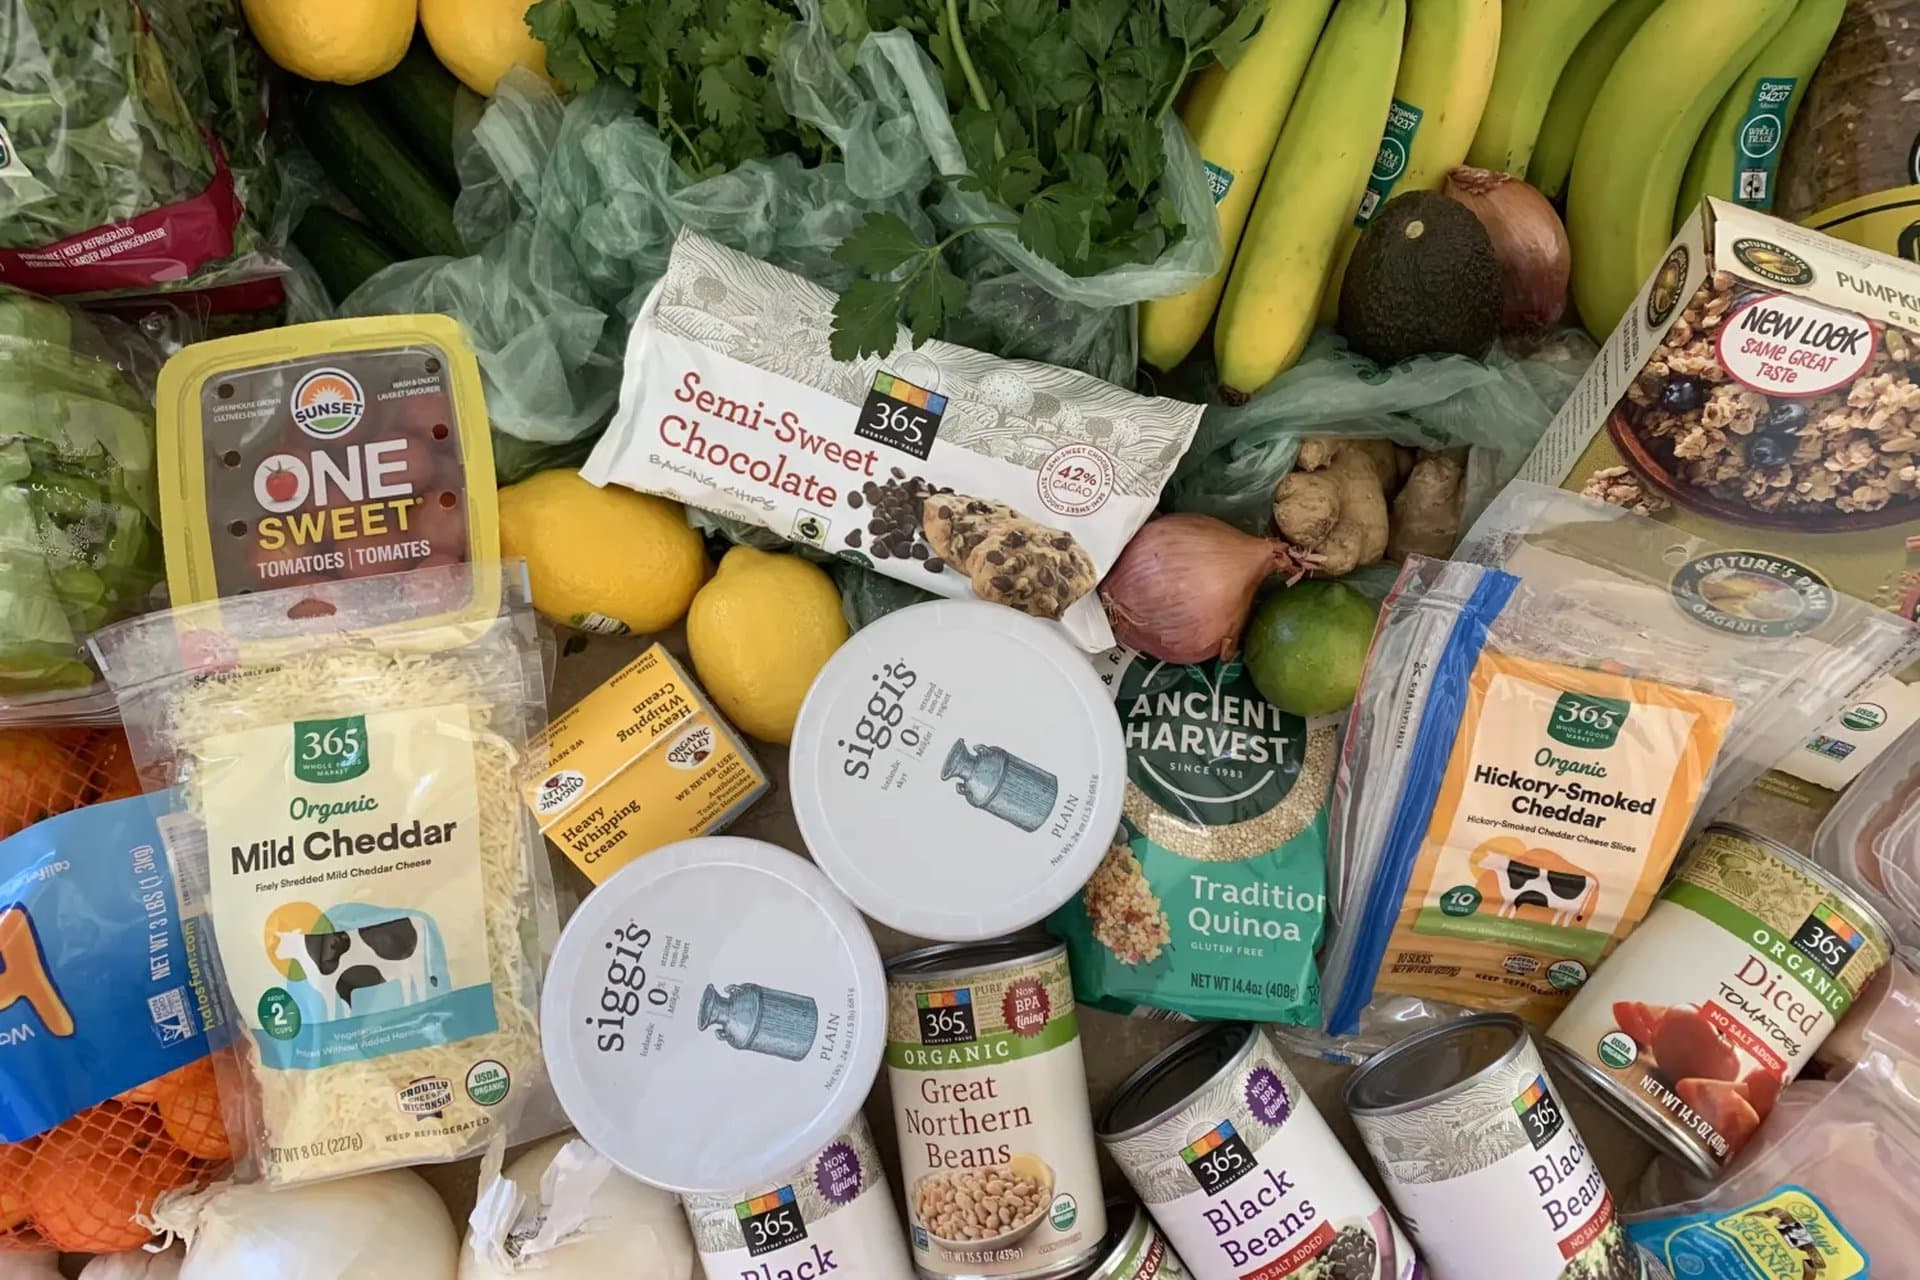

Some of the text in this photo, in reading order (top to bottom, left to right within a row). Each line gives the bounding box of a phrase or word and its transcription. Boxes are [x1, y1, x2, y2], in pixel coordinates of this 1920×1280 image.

[1758, 92, 1789, 102] 94237
[1761, 82, 1792, 95] Organic
[1391, 104, 1418, 122] Organic
[64, 226, 135, 256] KEEP REFRIGERATED
[100, 248, 112, 258] AU
[1753, 266, 1796, 283] ORGANIC
[1803, 318, 1869, 356] LOOK
[1788, 349, 1838, 374] GREAT
[295, 402, 363, 424] SUNSET
[674, 371, 879, 477] Semi-Sweet
[870, 402, 929, 444] 365
[859, 426, 929, 458] EVERYDAY VALUE
[254, 438, 412, 513] ONE
[660, 414, 838, 508] Chocolate
[1046, 448, 1110, 486] SEMI-SWEET CHOCOLATE
[1058, 464, 1096, 486] 42%
[650, 454, 718, 490] BAKING
[724, 488, 776, 512] CHIPS
[1052, 479, 1092, 497] CACAO
[1065, 492, 1106, 512] SEMI-SWEET
[258, 498, 416, 550] SWEET
[258, 540, 432, 578] TOMATOES TOMATES
[1694, 556, 1827, 610] NATURE'S PATH
[1692, 604, 1768, 634] ORGANIC
[1101, 672, 1114, 686] &
[632, 682, 676, 714] Cream
[1128, 690, 1283, 732] ANCIENT
[616, 694, 685, 744] Whipping
[650, 704, 692, 737] Heavy
[1556, 724, 1582, 736] WHOLE
[1558, 700, 1622, 731] 365
[302, 727, 360, 761] 365
[668, 727, 711, 763] ORGANIC
[677, 735, 711, 765] VALLEY
[1126, 722, 1289, 765] HARVEST
[1566, 734, 1596, 744] MARKET
[302, 762, 332, 771] WHOLE
[316, 767, 350, 778] MARKET
[718, 761, 740, 780] GMOs
[1170, 761, 1244, 779] SINCE 1983
[1534, 747, 1608, 778] Organic
[540, 776, 584, 812] ORGANIC
[543, 776, 576, 800] VALLEY
[676, 768, 719, 802] WE NEVER
[708, 768, 746, 798] Antibiotics
[718, 774, 752, 802] Pesticides
[1474, 764, 1657, 816] Hickory-Smoked
[290, 794, 380, 824] Organic
[688, 808, 720, 834] Synthetic
[1051, 795, 1080, 840] PLAIN
[1511, 795, 1606, 830] Cheddar
[562, 806, 606, 844] Heavy
[572, 800, 642, 855] Whipping
[1466, 814, 1636, 854] Hickory-Smoked Cheddar Cheese Slices
[230, 835, 295, 876] Mild
[304, 819, 458, 861] Cheddar
[584, 832, 628, 866] Cream
[255, 858, 432, 893] Finely Shredded Mild Cheddar Cheese
[1694, 860, 1718, 874] BEST
[143, 891, 167, 917] LBS
[1450, 892, 1474, 906] 10
[150, 916, 167, 928] 3
[1188, 907, 1300, 942] Quinoa
[150, 931, 168, 954] WT
[1190, 941, 1264, 957] GLUTEN FREE
[1802, 926, 1847, 966] 365
[151, 956, 169, 981] NET
[1558, 964, 1581, 977] USDA
[1752, 930, 1844, 1010] ORGANIC
[1190, 972, 1300, 1001] NET WT 14.4oz (408g)
[1734, 954, 1824, 1037] Diced
[271, 1002, 288, 1026] 2
[1015, 996, 1041, 1013] BPA
[1720, 982, 1802, 1057] TOMATOES
[274, 1026, 294, 1034] CUPS
[820, 1012, 840, 1062] PLAIN
[926, 1010, 966, 1037] 365
[360, 1036, 391, 1050] Added
[904, 1040, 1010, 1066] ORGANIC
[1610, 1035, 1632, 1055] USDA
[1710, 1009, 1782, 1070] NO SALT ADDED
[400, 1080, 448, 1099] PROUDLY
[473, 1082, 506, 1096] ORGANIC
[474, 1069, 500, 1085] USDA
[921, 1076, 998, 1104] Great
[1251, 1075, 1270, 1097] NON-
[402, 1093, 452, 1112] WISCONSIN
[1259, 1086, 1276, 1105] BPA
[1264, 1094, 1287, 1120] Lining
[1640, 1075, 1714, 1140] NET WT 14.5 OZ
[386, 1116, 490, 1142] KEEP REFRIGERATED
[906, 1105, 1032, 1136] Northern
[1529, 1098, 1558, 1138] 365
[282, 1132, 364, 1162] WT 8 OZ (227g)
[824, 1152, 848, 1172] NON-
[926, 1143, 1011, 1169] Beans
[830, 1164, 850, 1182] BPA
[1200, 1144, 1245, 1185] 365
[1529, 1128, 1585, 1197] Black
[831, 1173, 858, 1196] Lining
[1208, 1162, 1256, 1195] EVERYDAY VALUE
[1202, 1169, 1295, 1237] Black
[1542, 1164, 1602, 1232] Beans
[750, 1210, 795, 1246] 365
[1220, 1200, 1316, 1268] Beans
[1570, 1220, 1600, 1250] NO SALT
[752, 1240, 782, 1255] EVERYDAY
[966, 1248, 1024, 1263] 15.5 OZ (439g)
[1268, 1235, 1324, 1277] SALT ADDED
[1742, 1216, 1802, 1274] CHICKEN
